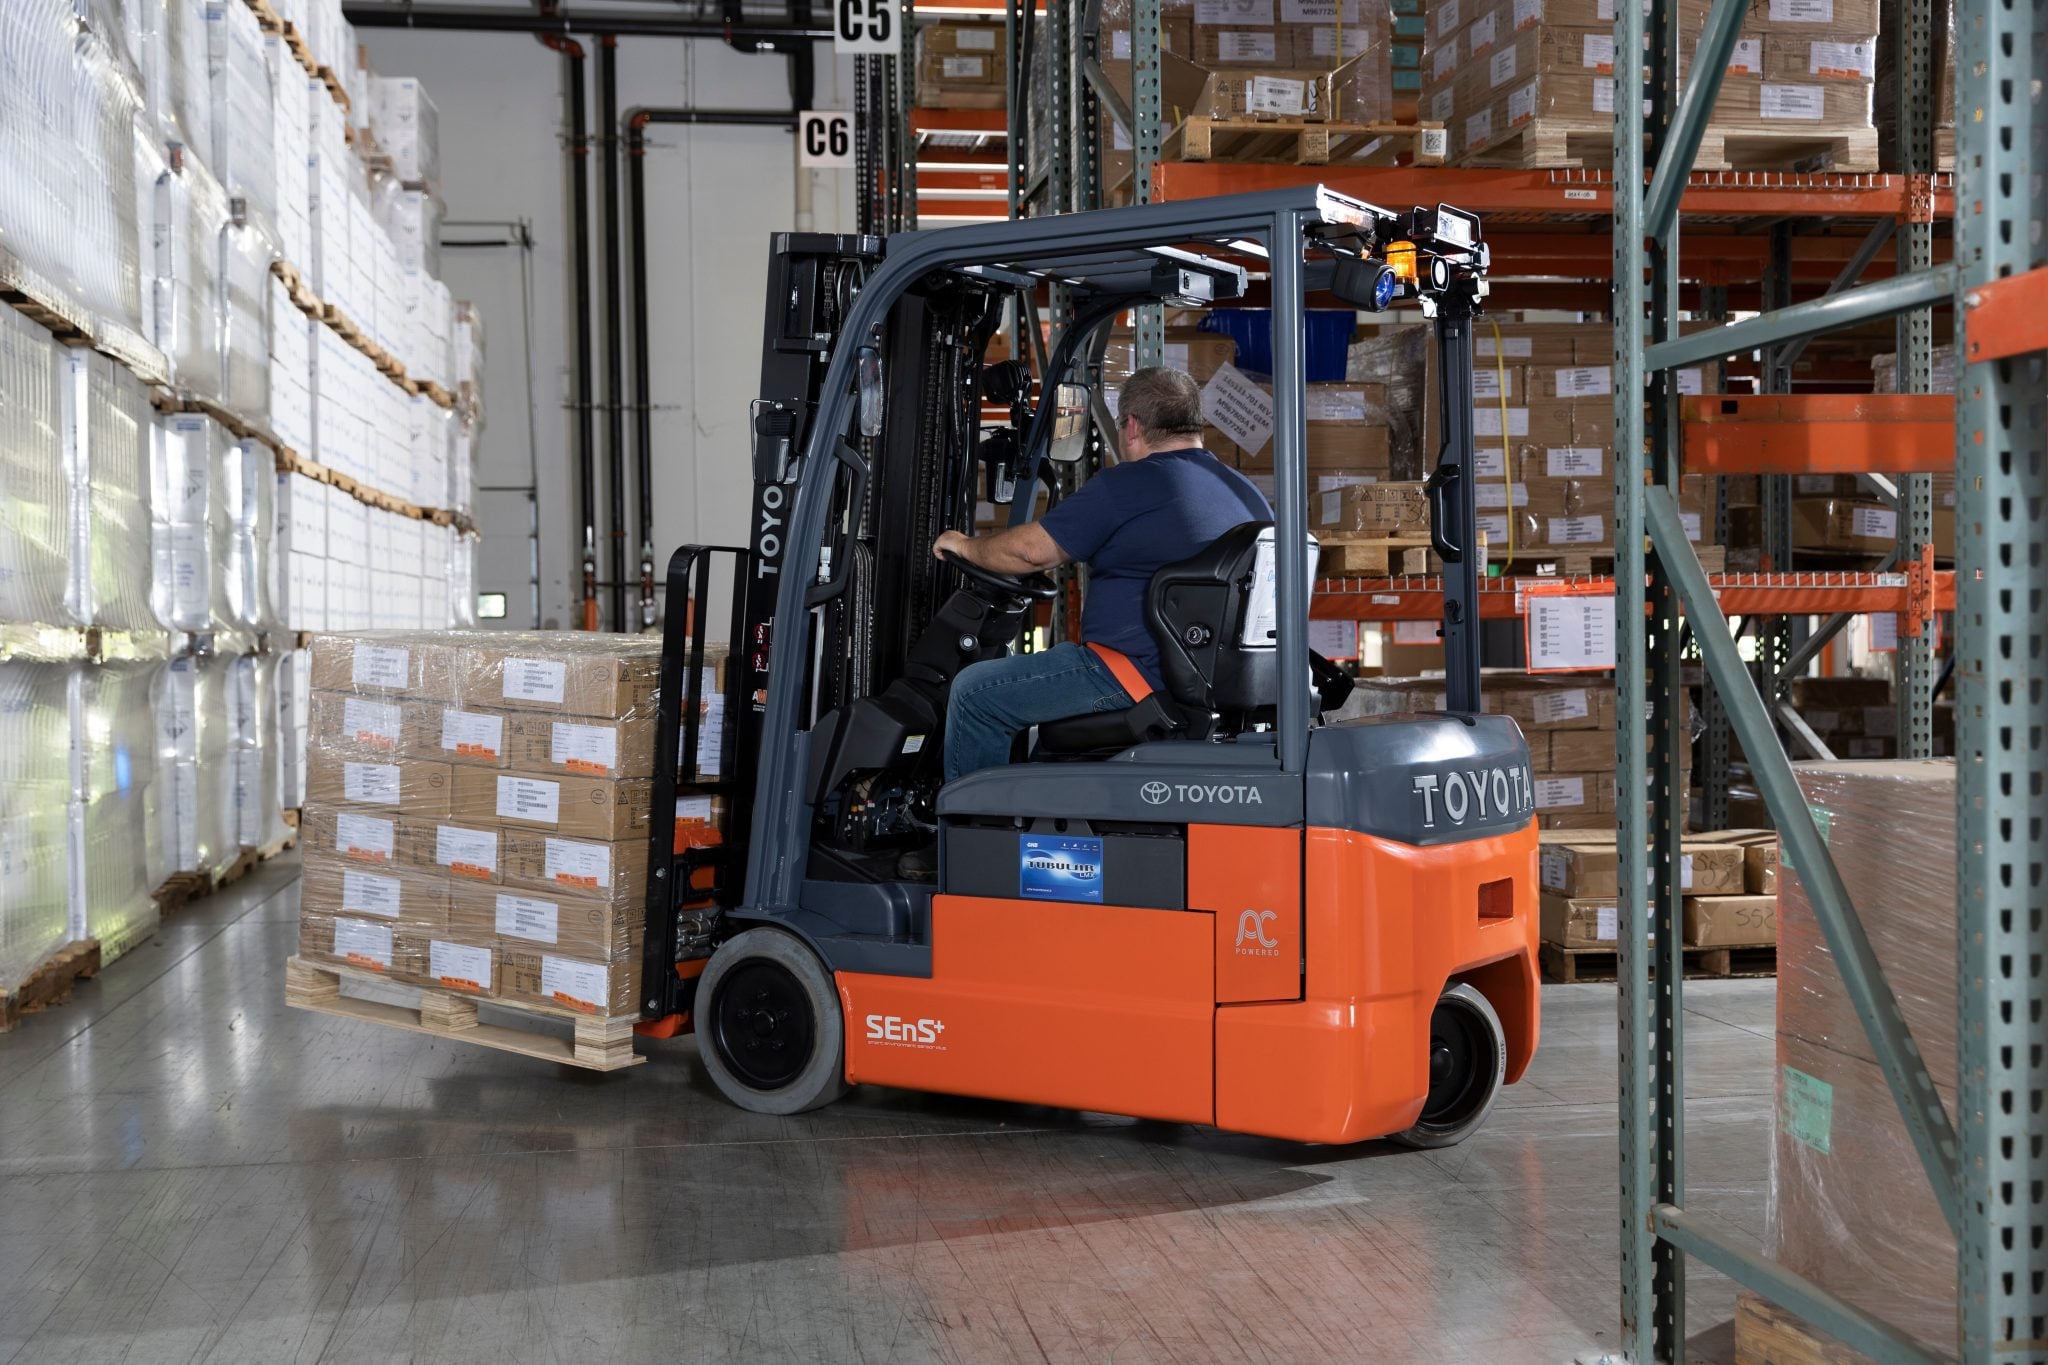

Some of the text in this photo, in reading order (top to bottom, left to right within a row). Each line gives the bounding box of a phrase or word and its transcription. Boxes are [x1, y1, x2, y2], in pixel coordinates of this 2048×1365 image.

[840, 0, 891, 42] C5
[806, 117, 849, 157] C6
[1175, 784, 1262, 804] TOYOTA
[1413, 766, 1534, 828] TOYOTA
[1027, 861, 1094, 872] TUBULAR
[1236, 910, 1278, 948] AC
[1236, 948, 1279, 956] POWERED
